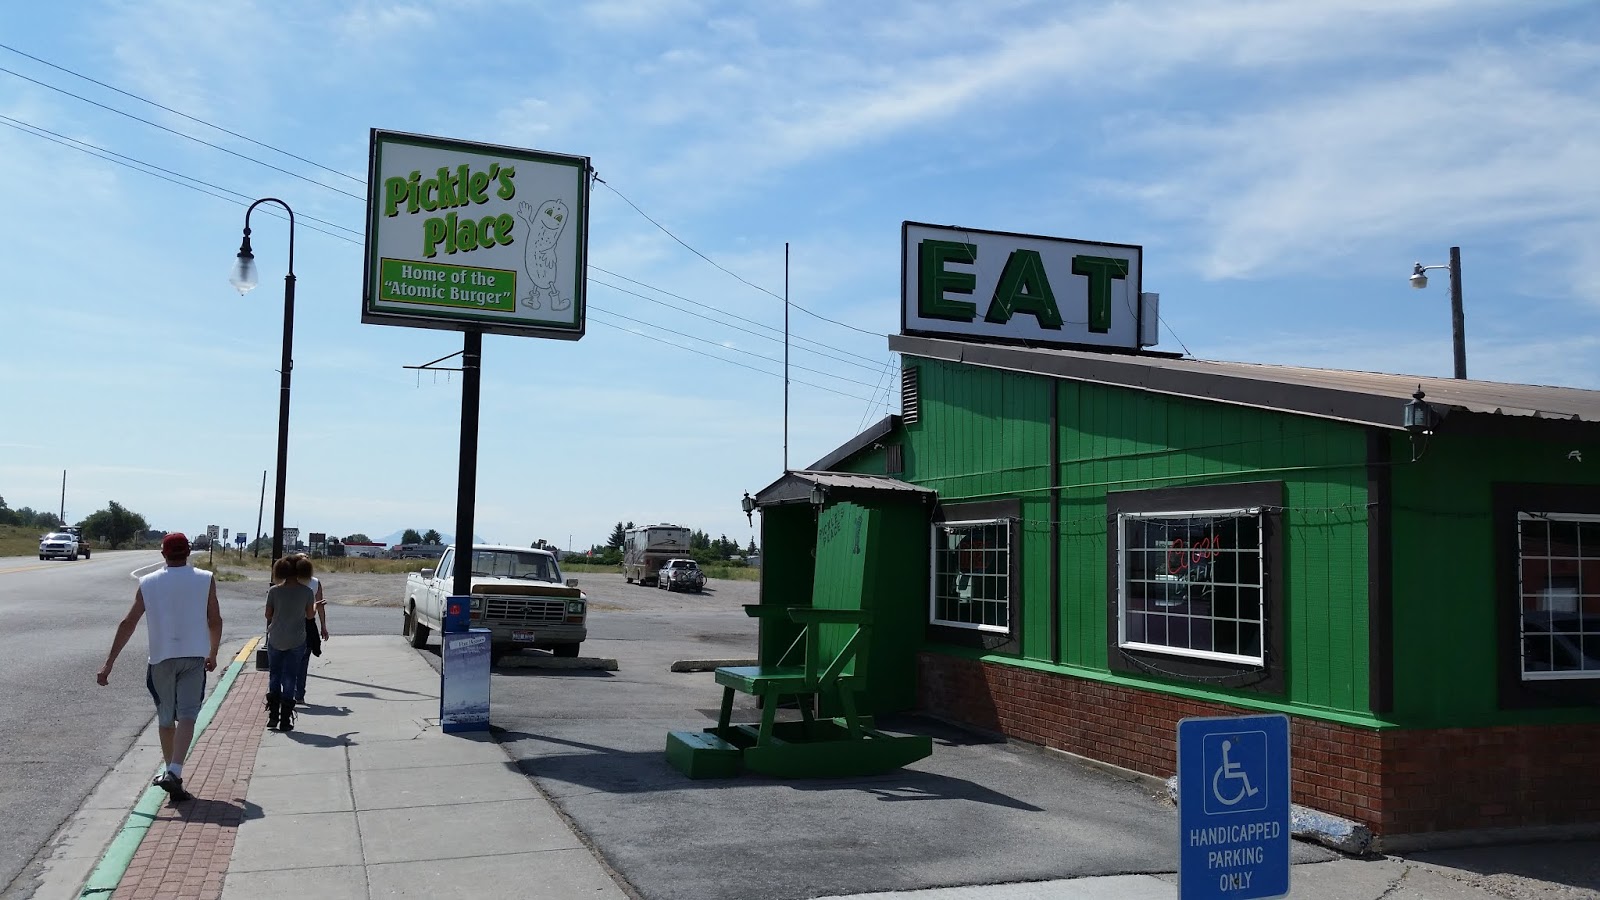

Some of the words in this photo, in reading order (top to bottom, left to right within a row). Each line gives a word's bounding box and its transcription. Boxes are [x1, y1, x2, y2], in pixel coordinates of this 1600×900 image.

[384, 162, 515, 217] Pickle's
[423, 212, 514, 258] Place
[401, 265, 446, 283] Home
[450, 270, 467, 285] of
[471, 272, 496, 287] the
[918, 238, 1129, 334] EAT
[384, 280, 446, 300] "Atomic
[450, 288, 511, 306] Burger"
[208, 531, 218, 539] 35
[1190, 821, 1280, 847] HANDICAPPED
[1208, 846, 1264, 869] PARKING
[1219, 871, 1252, 892] ONLY
